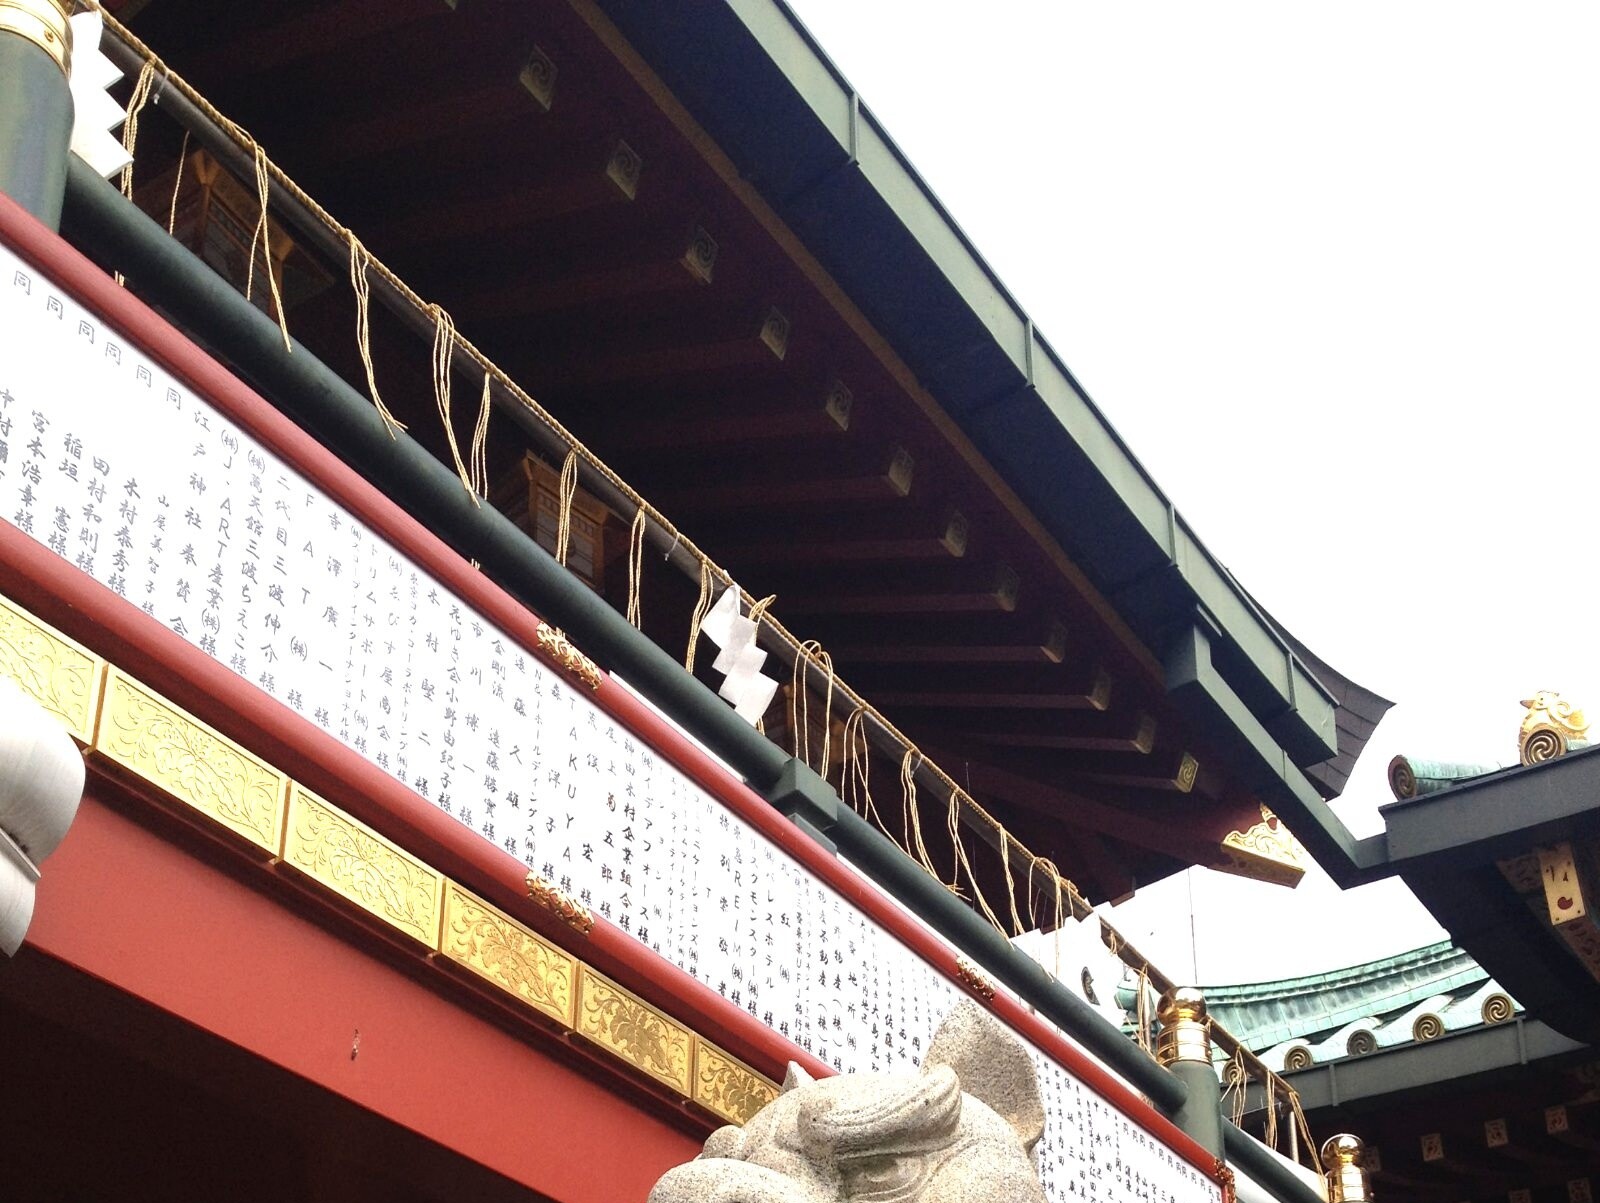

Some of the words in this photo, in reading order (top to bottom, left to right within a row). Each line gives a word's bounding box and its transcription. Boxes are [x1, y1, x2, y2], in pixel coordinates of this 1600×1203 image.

[13, 271, 31, 296] 同
[46, 295, 64, 321] 同
[78, 320, 95, 345] 同
[105, 341, 122, 365] 同
[136, 364, 152, 388] 同
[166, 387, 182, 411] 同
